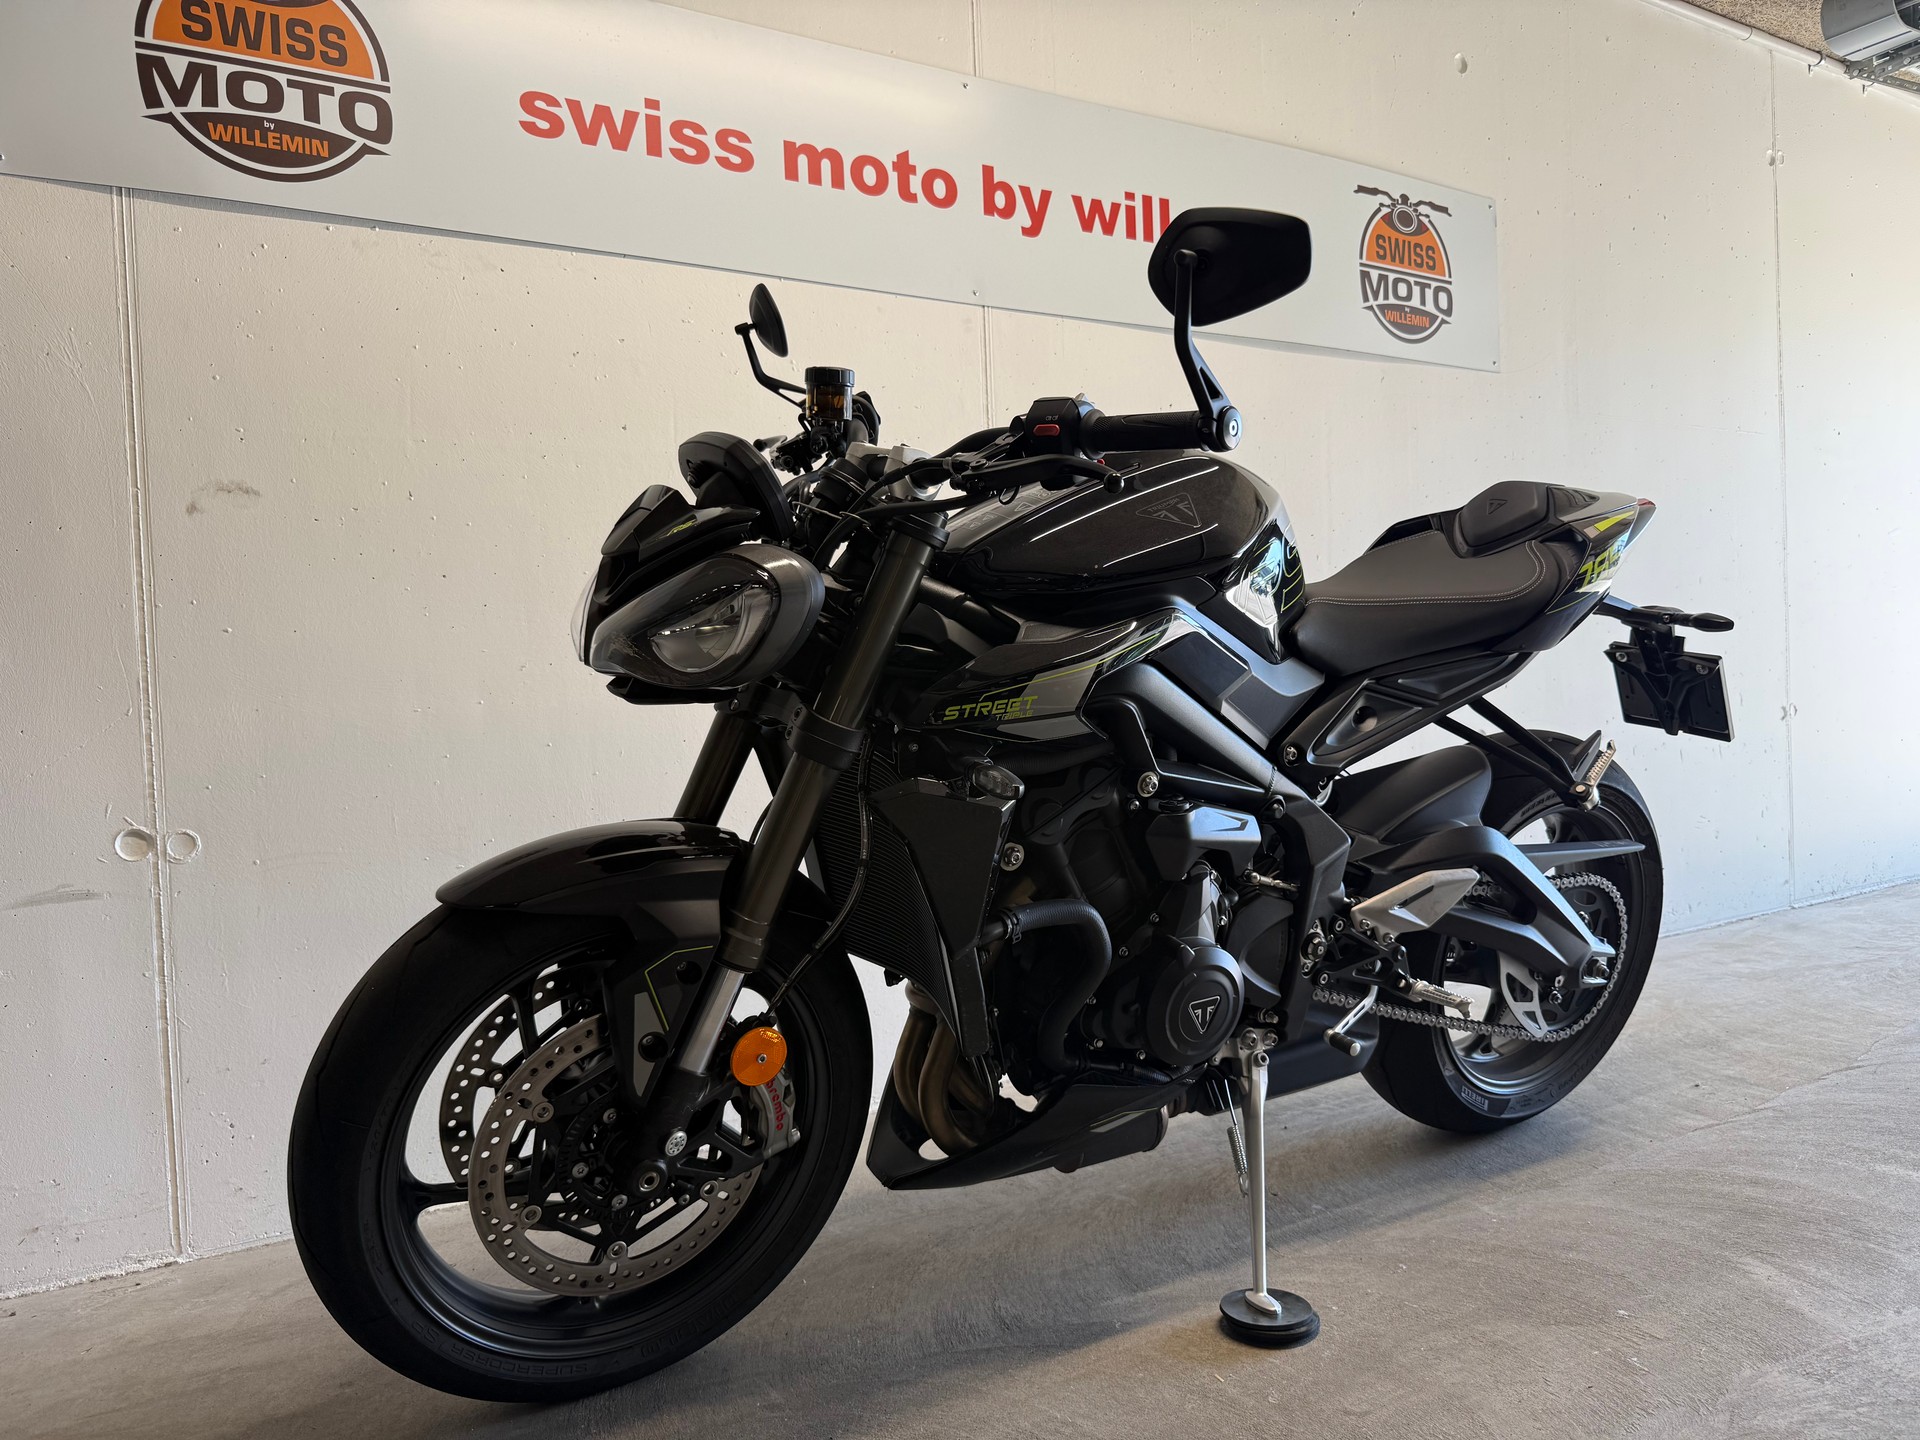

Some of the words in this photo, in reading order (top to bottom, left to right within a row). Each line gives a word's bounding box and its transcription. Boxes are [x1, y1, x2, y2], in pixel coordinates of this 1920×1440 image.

[180, 0, 349, 68] SWISS
[136, 52, 393, 145] MOTO
[206, 121, 330, 159] WILLEMIN
[263, 119, 275, 130] by
[519, 90, 755, 173] swiss
[783, 139, 958, 210] moto
[981, 164, 1053, 238] by
[1375, 233, 1437, 272] SWISS
[1359, 269, 1454, 319] MOTO
[1384, 309, 1430, 329] WILLEMIN
[943, 695, 1039, 721] STREET
[995, 709, 1034, 721] TRIPLE
